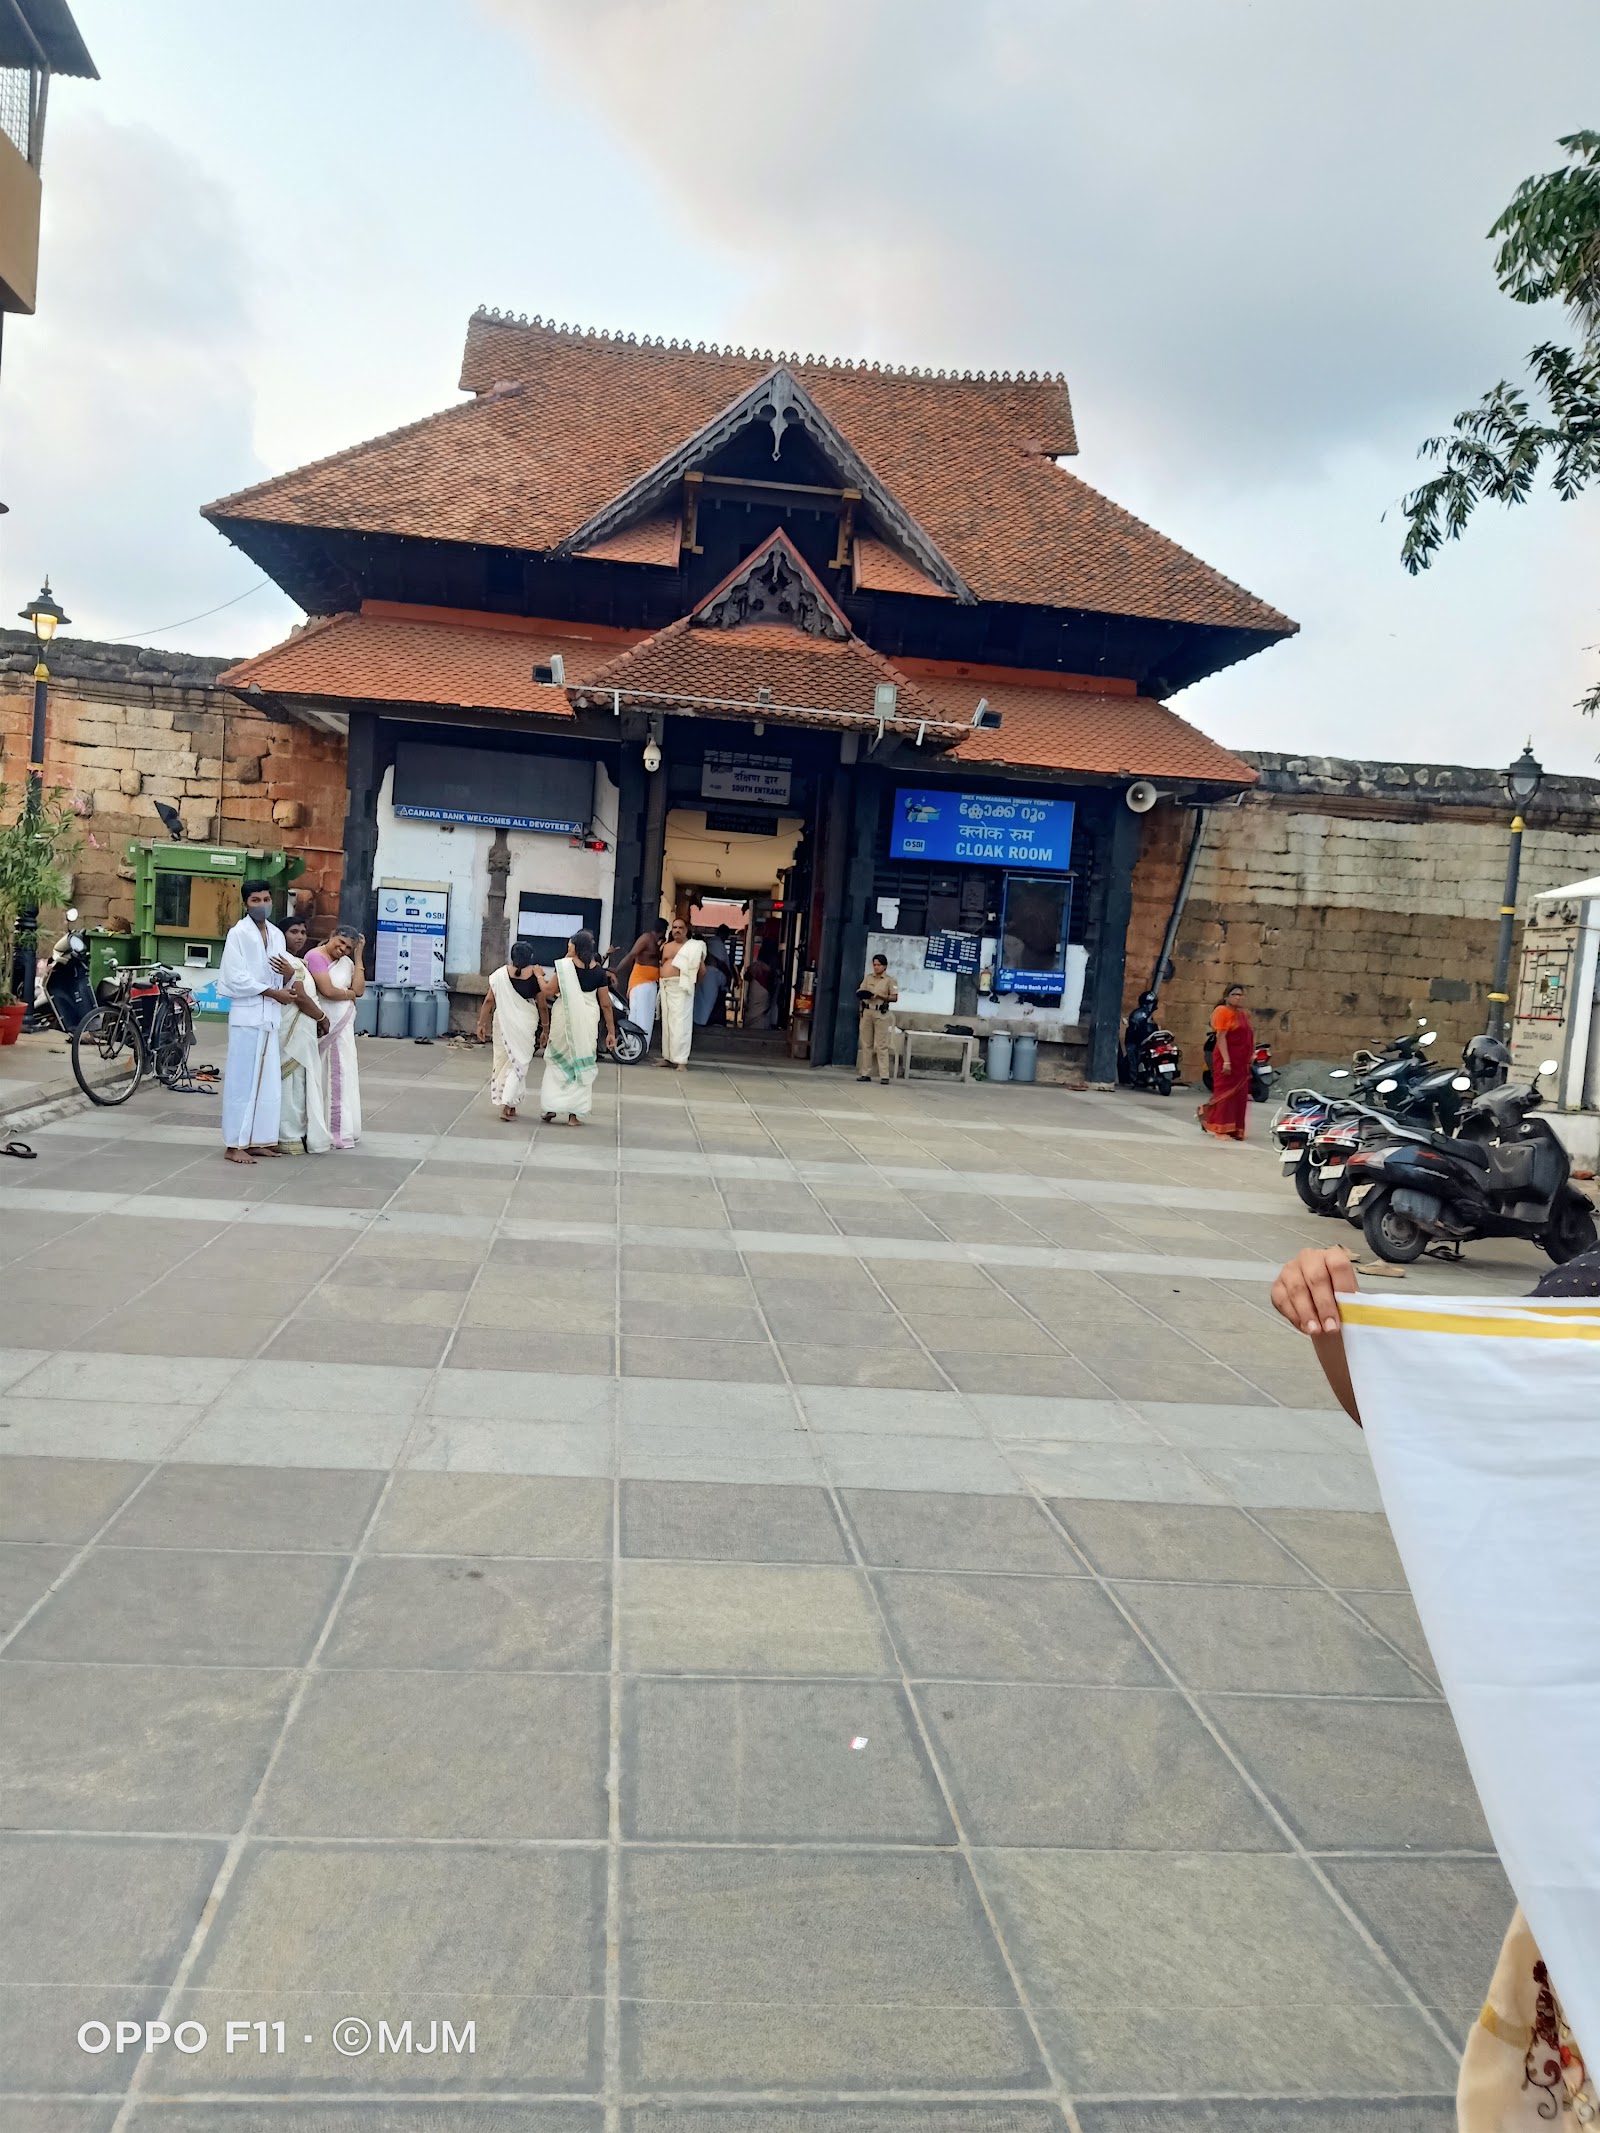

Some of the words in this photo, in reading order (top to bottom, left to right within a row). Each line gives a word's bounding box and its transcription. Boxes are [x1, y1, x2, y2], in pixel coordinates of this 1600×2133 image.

[734, 770, 760, 782] दक्षिण
[764, 775, 779, 785] द्वार
[732, 784, 753, 793] SOUTH
[754, 786, 787, 797] ENTRANCE
[407, 808, 441, 819] CANARA
[442, 811, 465, 821] BANK
[466, 815, 511, 826] WELCOMES
[512, 819, 527, 828] ALL
[529, 820, 570, 832] DEVOTEES
[958, 821, 1005, 840] क्लोक
[911, 841, 923, 849] SBI
[955, 842, 1004, 858] CLOAK
[1008, 846, 1053, 862] ROOM
